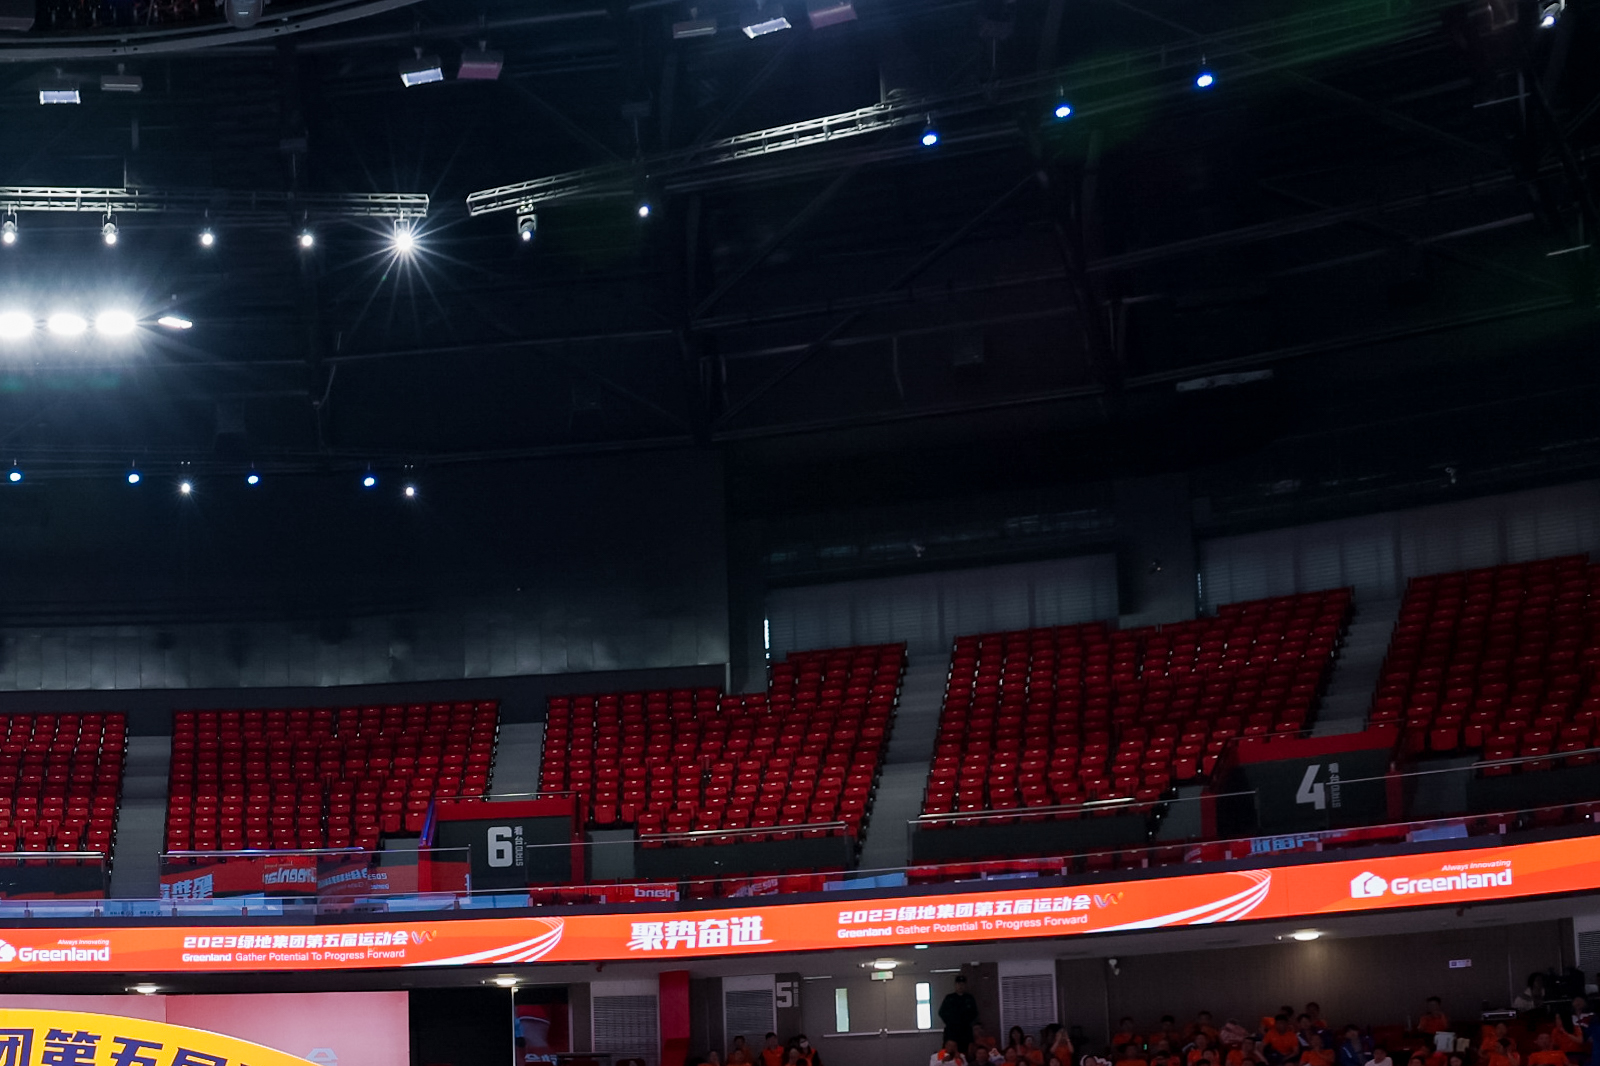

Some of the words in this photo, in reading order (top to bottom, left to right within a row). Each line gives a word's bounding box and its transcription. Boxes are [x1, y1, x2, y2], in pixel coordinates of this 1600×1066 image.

[1296, 764, 1326, 810] 4
[488, 826, 513, 868] 6
[1441, 862, 1468, 872] Always
[1469, 859, 1512, 869] Innovating
[1391, 869, 1512, 895] Greenland
[838, 894, 1091, 925] 2023绿地集团第五届运动会
[626, 915, 776, 952] 聚势奋进
[837, 927, 892, 939] Greenland
[896, 925, 931, 935] Gather
[933, 922, 979, 933] Potential
[981, 920, 993, 930] To
[995, 918, 1042, 931] Progress
[1044, 914, 1088, 926] Forward
[183, 930, 408, 949] 2023绿地集团第五届运动会
[19, 946, 110, 962] Greenland
[182, 952, 232, 962] Greenland
[235, 952, 267, 962] Gather
[269, 951, 309, 961] Potential
[311, 952, 322, 961] To
[324, 950, 365, 962] Progress
[367, 949, 405, 959] Forward
[776, 982, 792, 1007] 5
